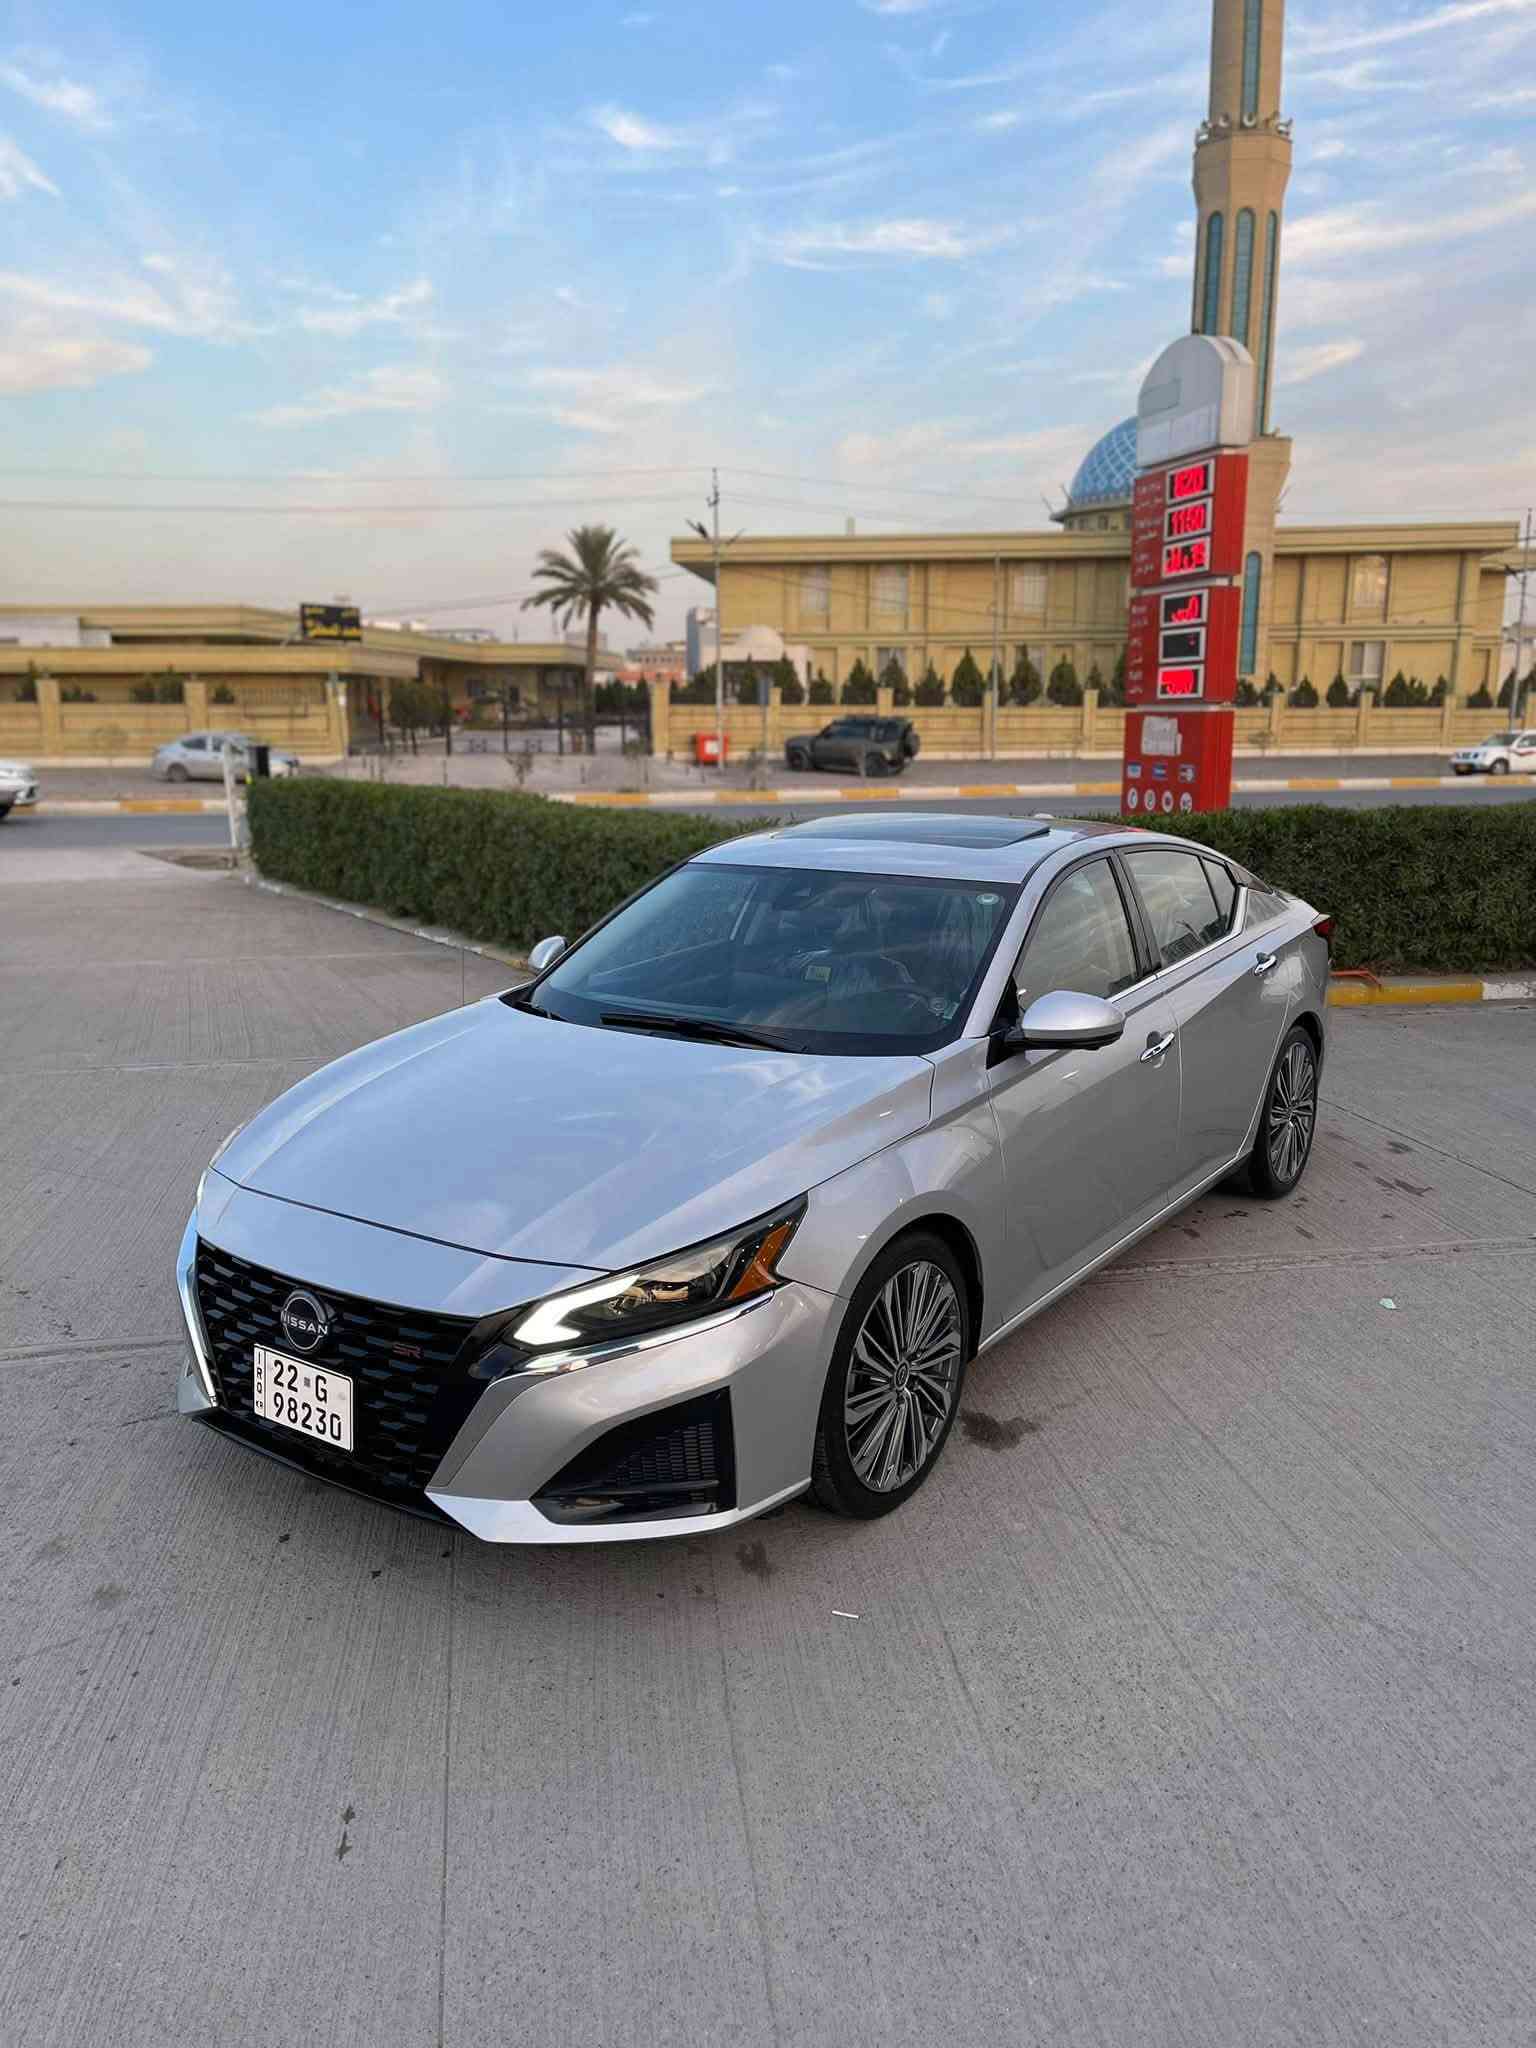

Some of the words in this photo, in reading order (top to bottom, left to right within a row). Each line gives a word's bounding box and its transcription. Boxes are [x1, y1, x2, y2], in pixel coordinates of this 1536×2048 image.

[280, 1310, 329, 1336] NISSAN
[273, 1359, 299, 1393] 22
[315, 1374, 328, 1404] G
[273, 1391, 342, 1441] 98230
